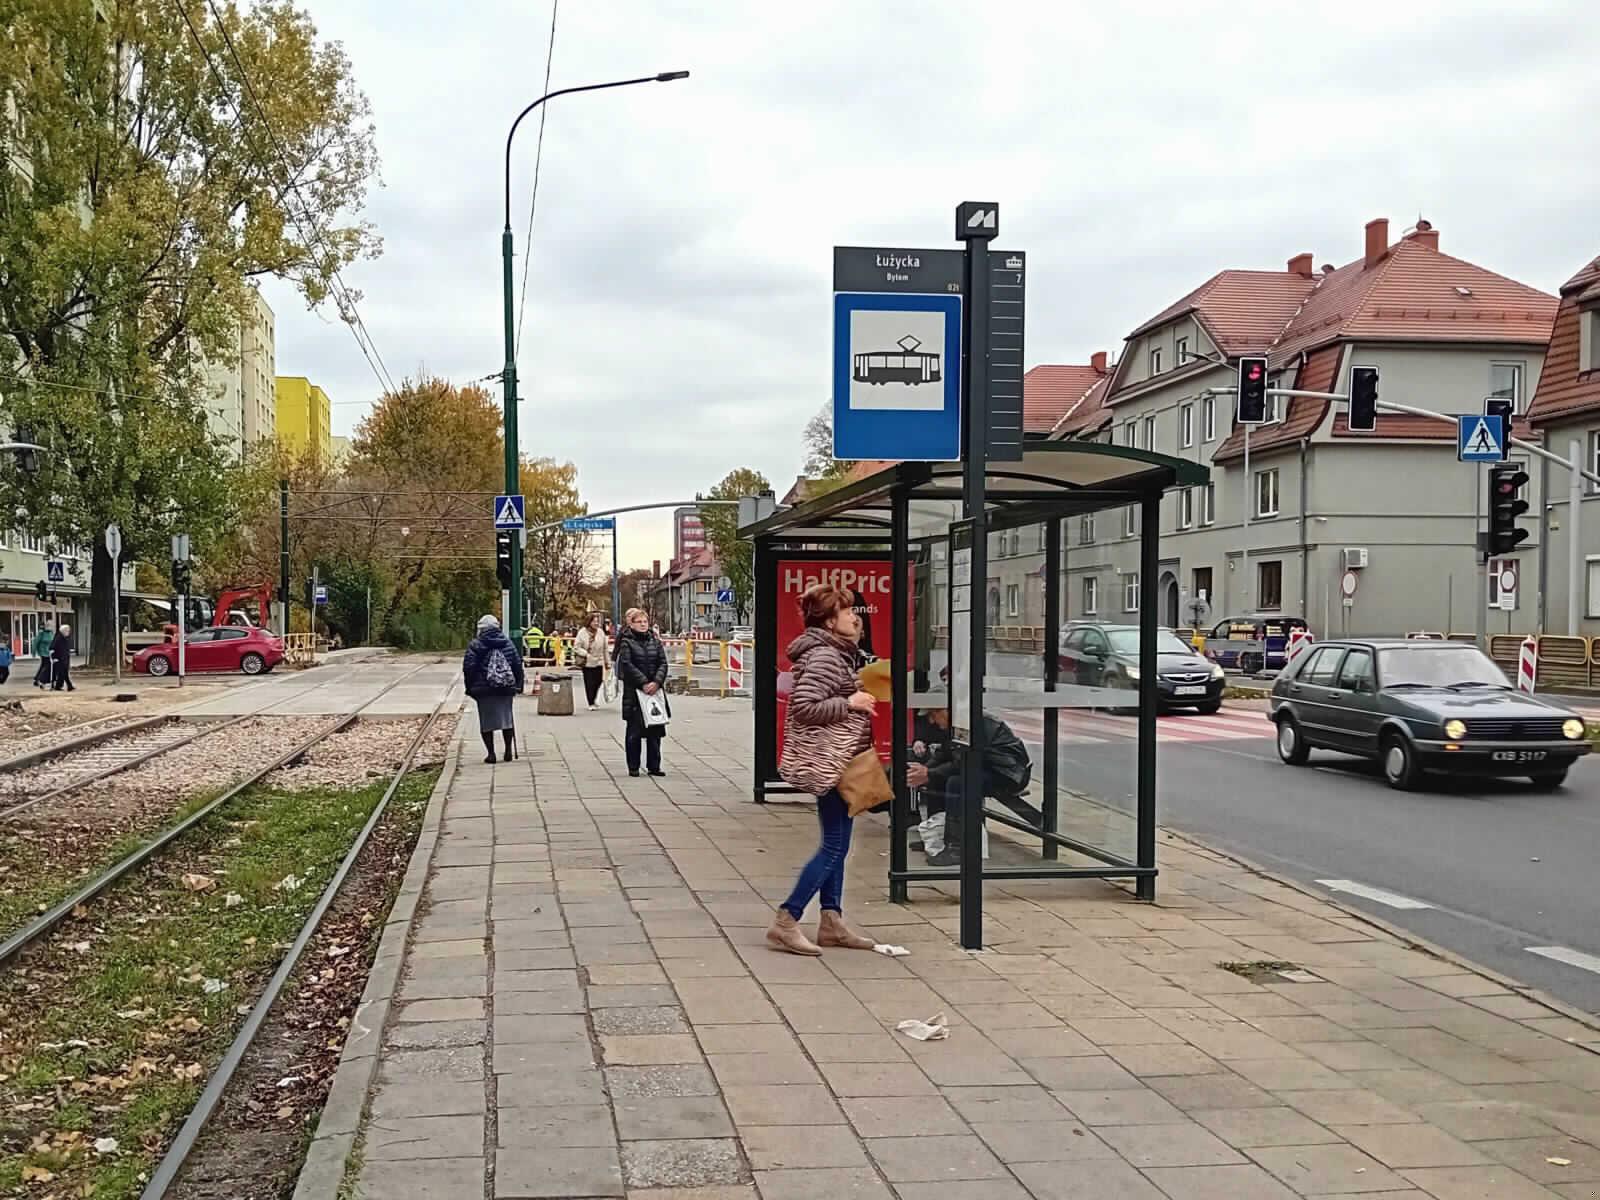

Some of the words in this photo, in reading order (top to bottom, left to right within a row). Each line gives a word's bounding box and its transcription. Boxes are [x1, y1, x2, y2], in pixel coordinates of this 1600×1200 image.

[876, 253, 920, 270] Łużycka
[1015, 273, 1022, 283] 7
[784, 568, 891, 593] HalfPric
[850, 603, 878, 614] rands
